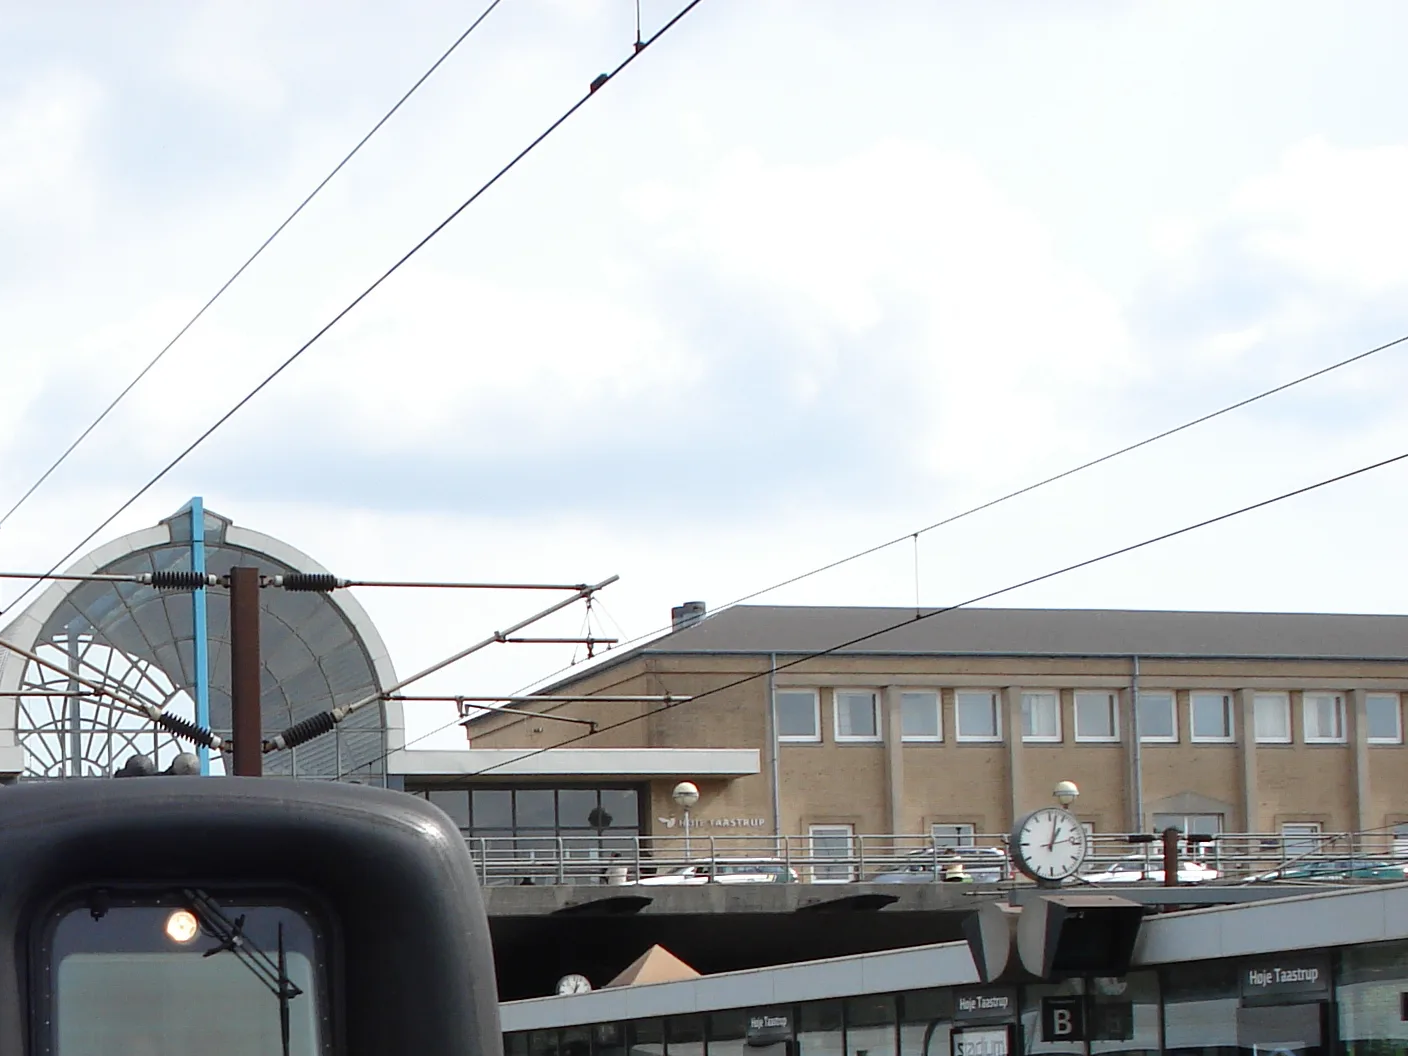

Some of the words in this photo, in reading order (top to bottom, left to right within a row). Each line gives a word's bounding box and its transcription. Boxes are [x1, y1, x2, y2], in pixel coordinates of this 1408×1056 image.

[1250, 970, 1273, 987] Høje
[1274, 967, 1319, 983] Taastrup
[976, 995, 1008, 1010] Taastrup
[1054, 1009, 1073, 1035] B
